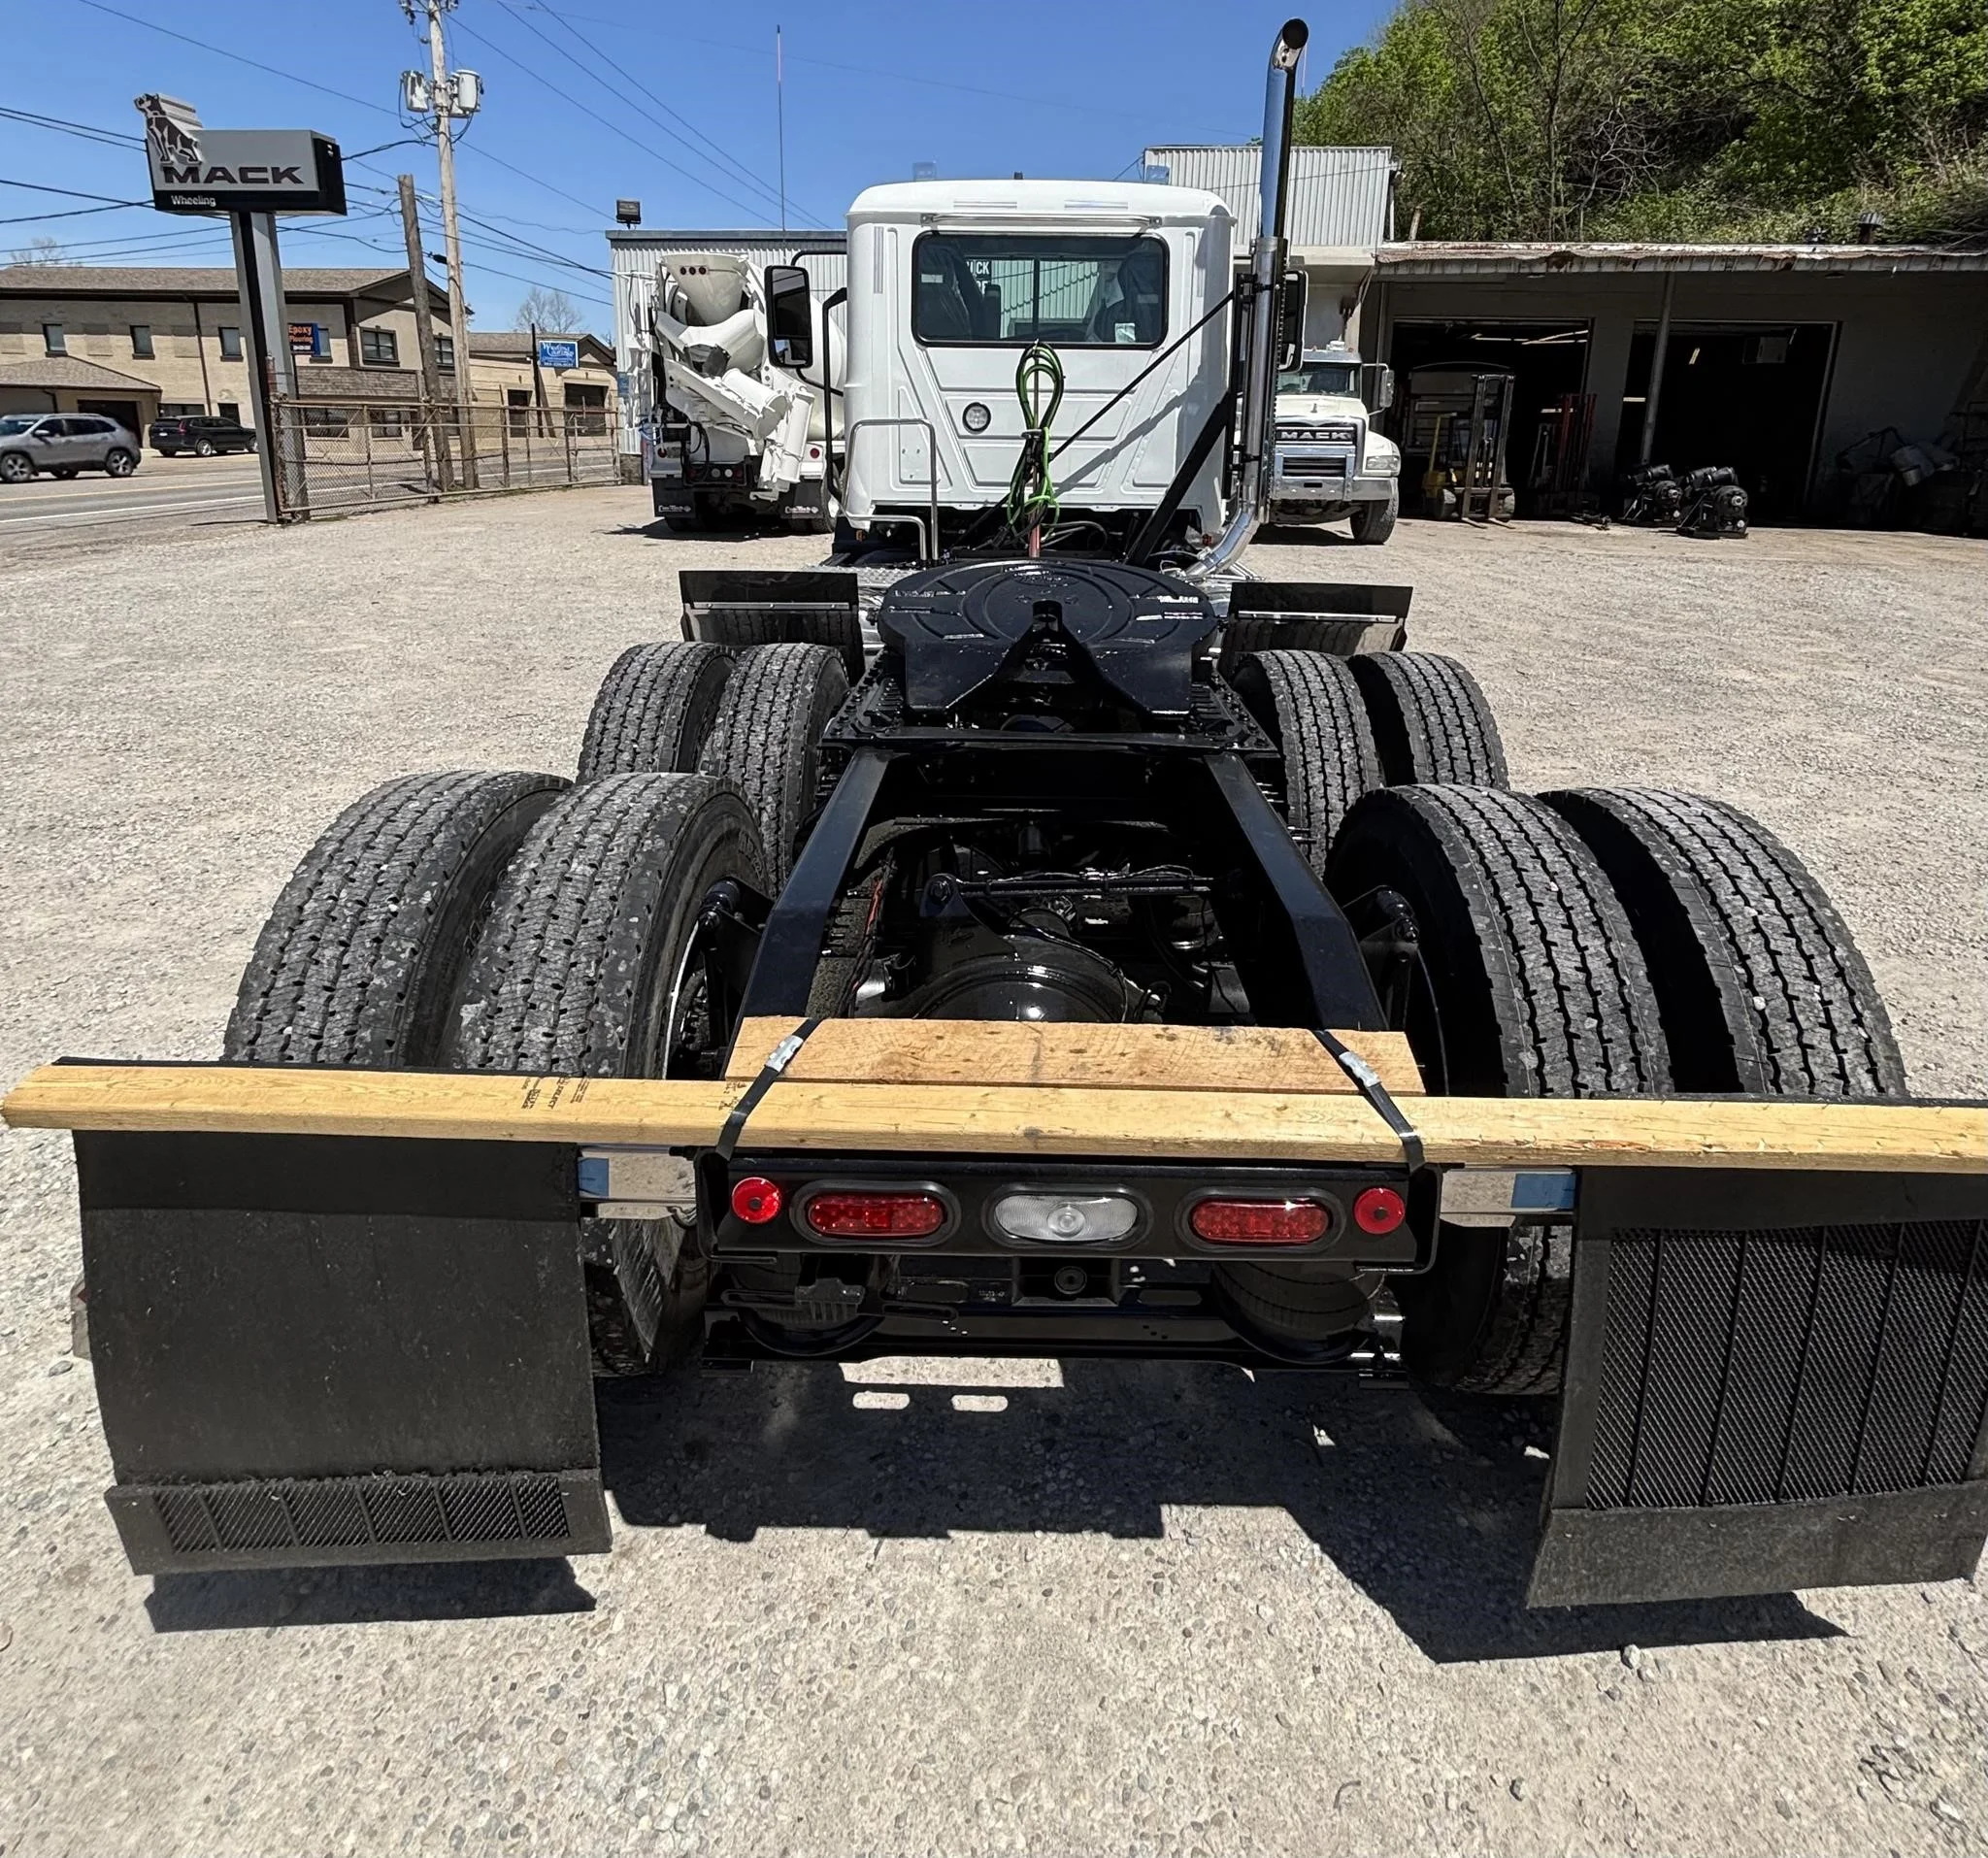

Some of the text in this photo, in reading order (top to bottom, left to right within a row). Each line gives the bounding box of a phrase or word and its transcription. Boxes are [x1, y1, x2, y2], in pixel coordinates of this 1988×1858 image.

[162, 166, 305, 184] MACK
[171, 195, 217, 207] Wheeling
[288, 325, 313, 336] Epoxy
[1280, 431, 1351, 440] MACK
